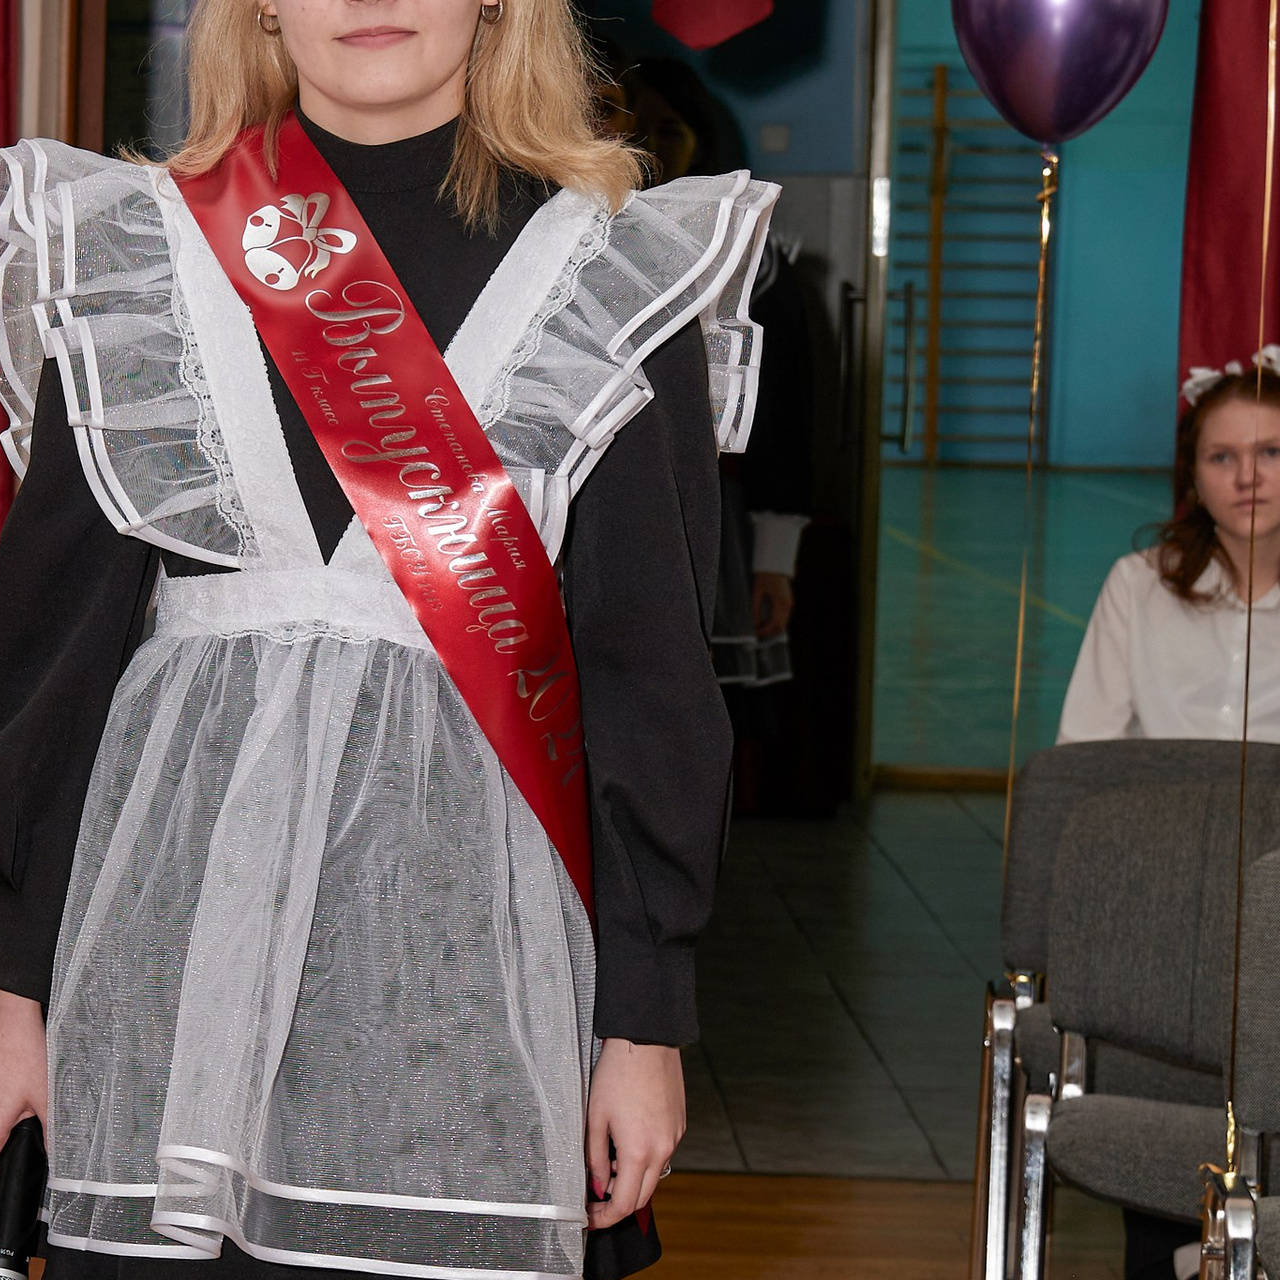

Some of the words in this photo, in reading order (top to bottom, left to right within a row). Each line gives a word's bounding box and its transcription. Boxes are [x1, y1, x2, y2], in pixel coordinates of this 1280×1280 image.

[305, 280, 530, 654] Выпускница
[310, 386, 339, 427] класс
[424, 387, 489, 494] Степанова
[480, 499, 527, 570] Мария
[382, 515, 431, 576] ГБОУ
